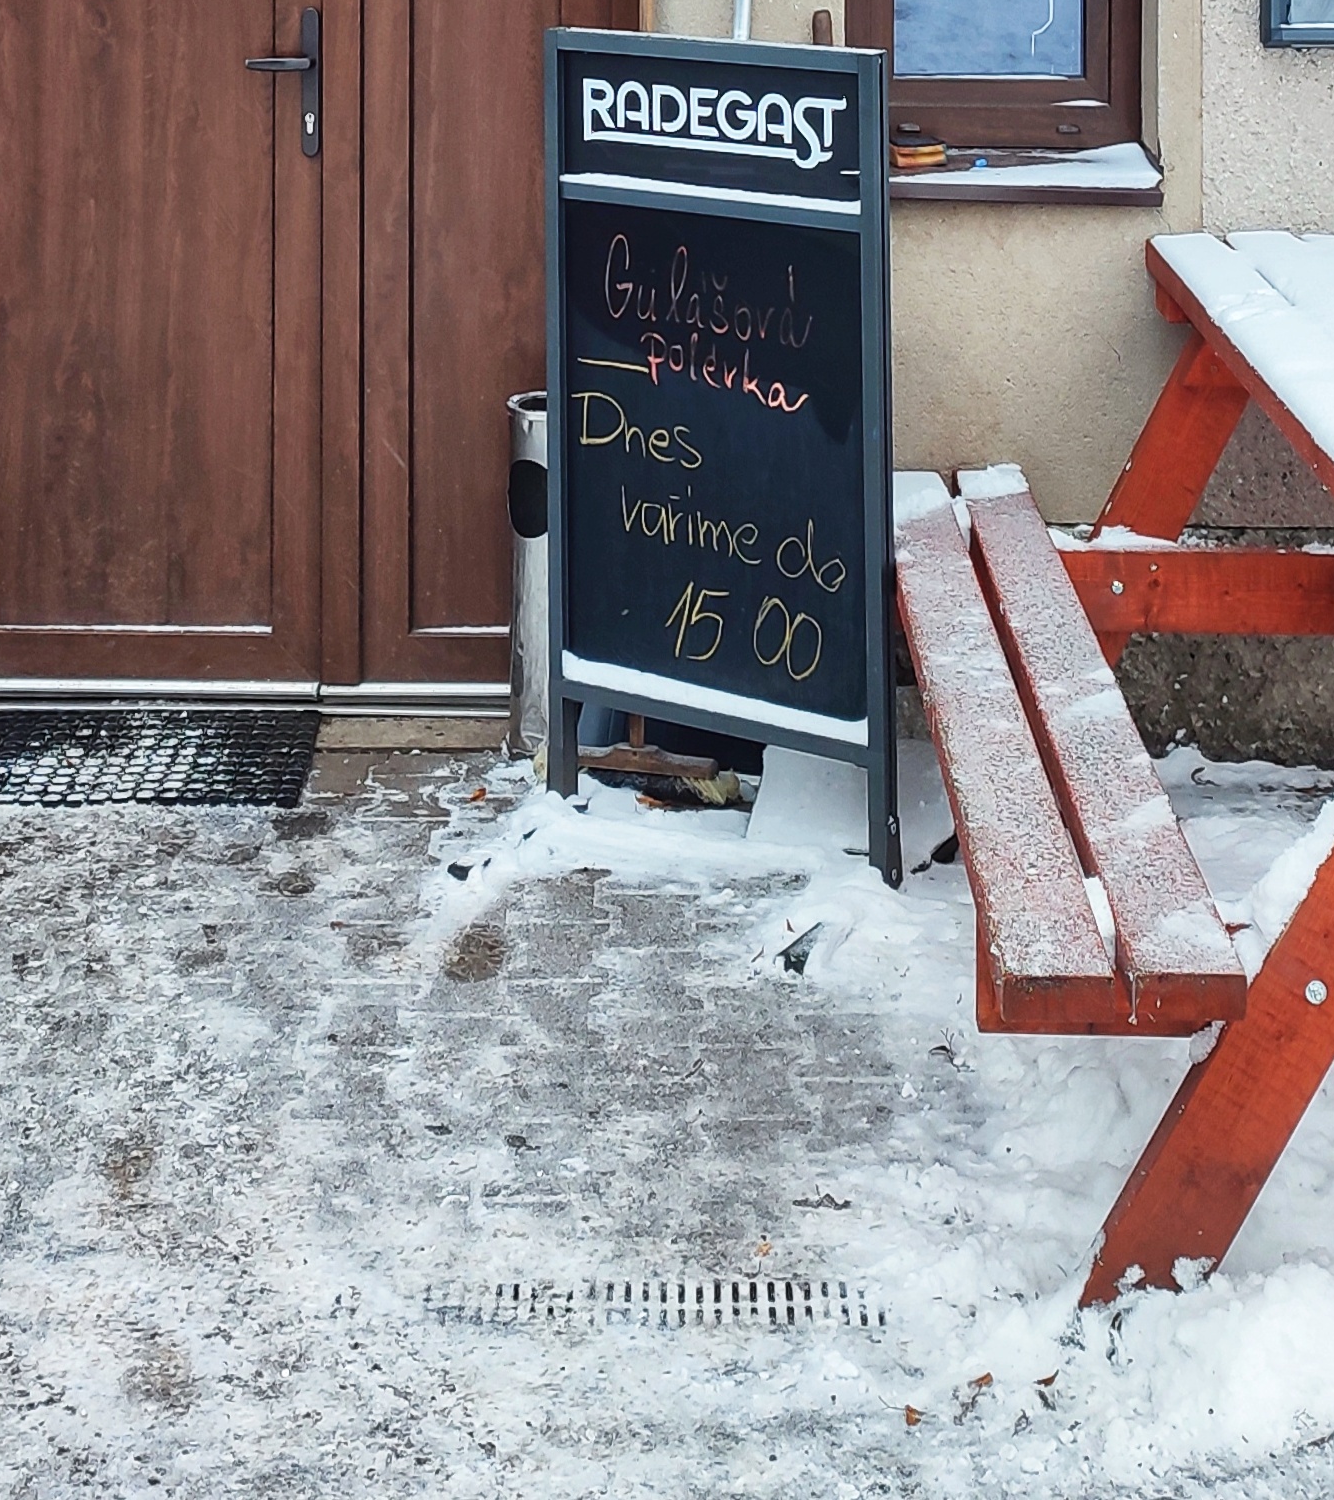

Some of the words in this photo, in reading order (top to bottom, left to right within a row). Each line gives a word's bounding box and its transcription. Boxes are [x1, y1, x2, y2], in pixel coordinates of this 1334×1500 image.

[582, 77, 847, 169] RADEGAST
[571, 392, 703, 468] Dnes
[777, 519, 847, 592] do
[665, 581, 730, 660] 15
[753, 595, 822, 681] 00
